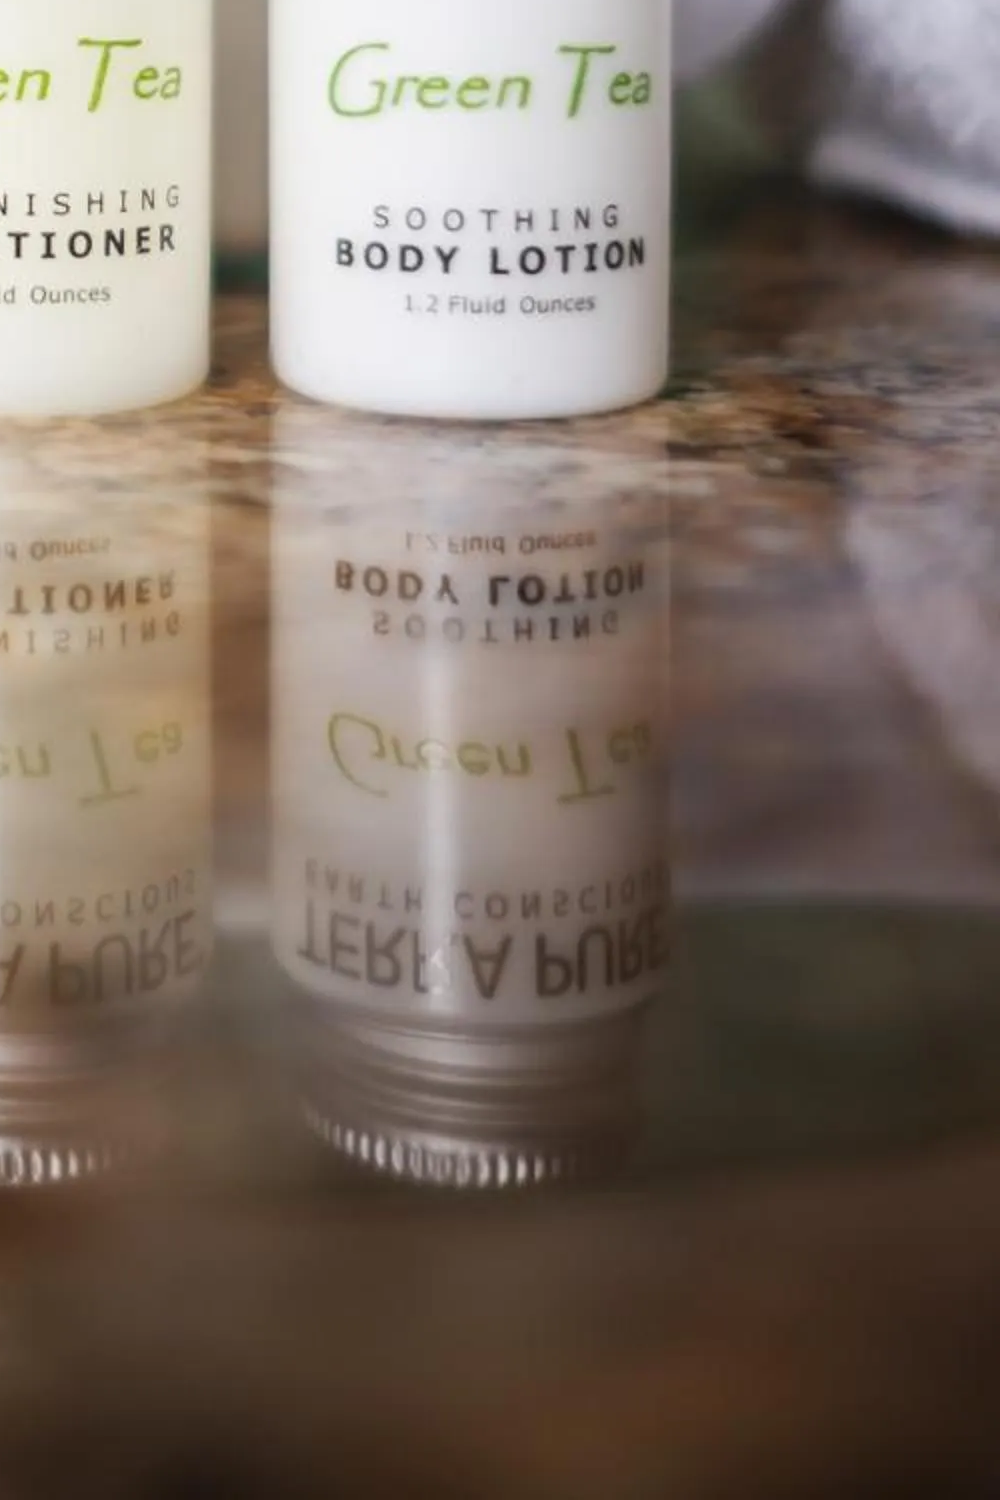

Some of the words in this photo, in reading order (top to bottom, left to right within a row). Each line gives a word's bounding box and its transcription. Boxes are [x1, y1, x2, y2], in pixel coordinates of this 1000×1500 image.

[77, 38, 182, 113] Tea
[327, 42, 532, 118] Green
[557, 45, 652, 119] Tea
[373, 205, 619, 232] SOOTHING
[335, 239, 460, 273] BODY
[488, 237, 646, 275] LOTION
[30, 285, 111, 305] Ounces
[404, 295, 438, 313] 1.2
[449, 296, 505, 314] Fluid
[520, 295, 596, 315] Ounces
